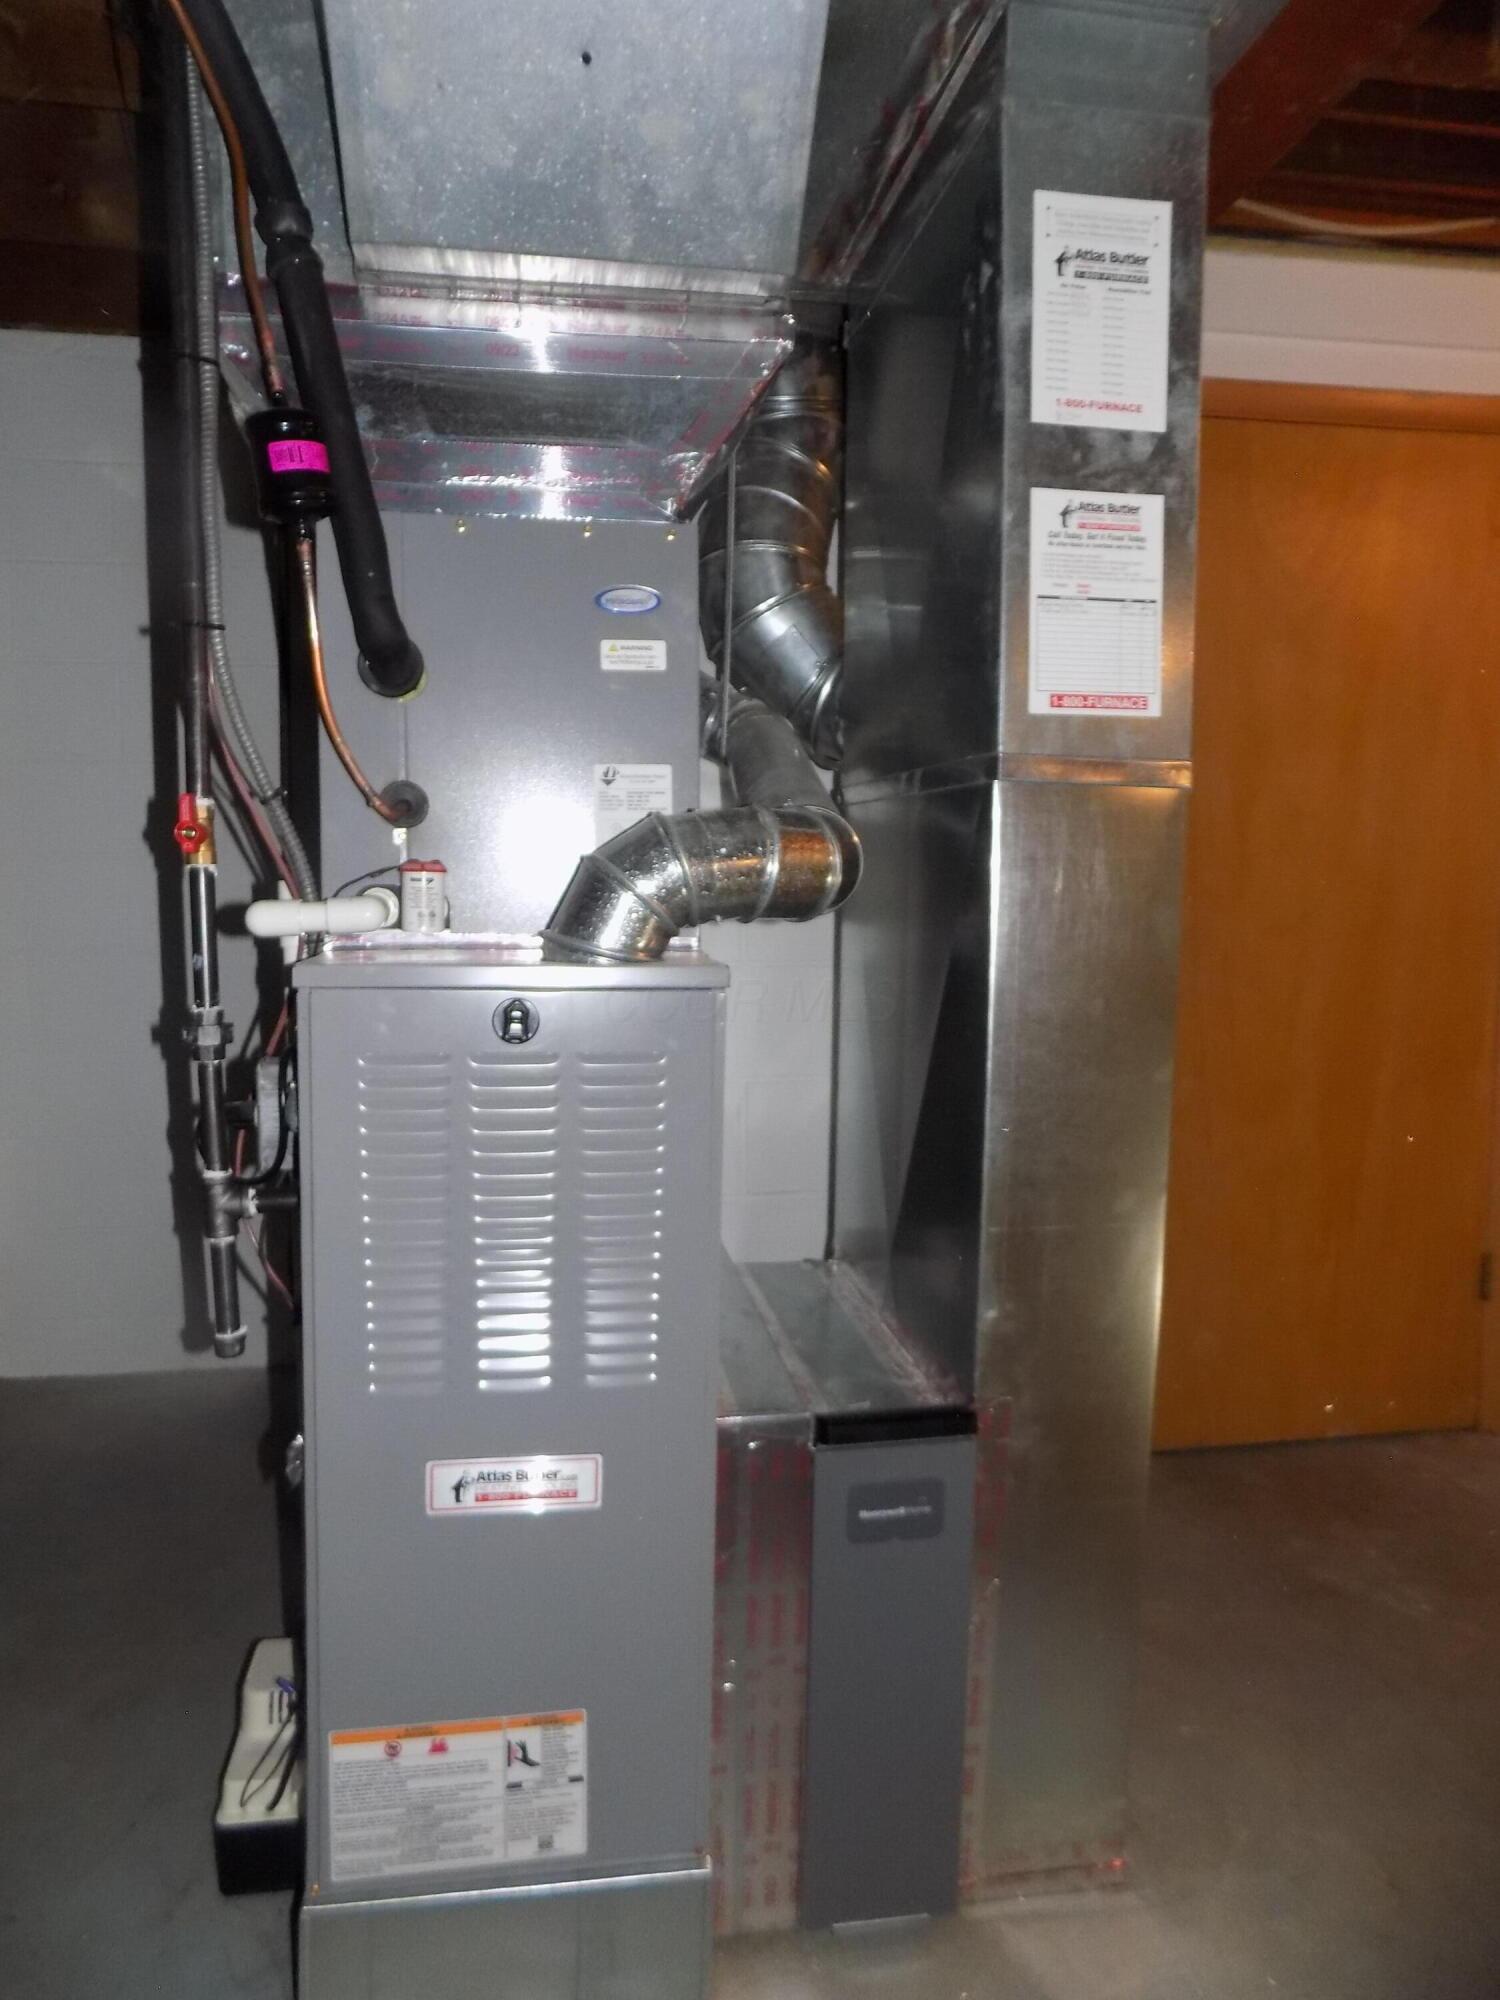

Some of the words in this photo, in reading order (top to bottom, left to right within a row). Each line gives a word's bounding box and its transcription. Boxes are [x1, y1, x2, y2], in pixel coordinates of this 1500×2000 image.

[1075, 249, 1106, 263] Atlas
[1109, 251, 1149, 266] Butler
[1056, 397, 1143, 414] 1-800-FURNACE
[1079, 501, 1105, 513] Atlas
[1107, 503, 1141, 515] Butler
[1051, 695, 1147, 710] 1-800-FURNACE
[477, 1469, 513, 1482] Atlas
